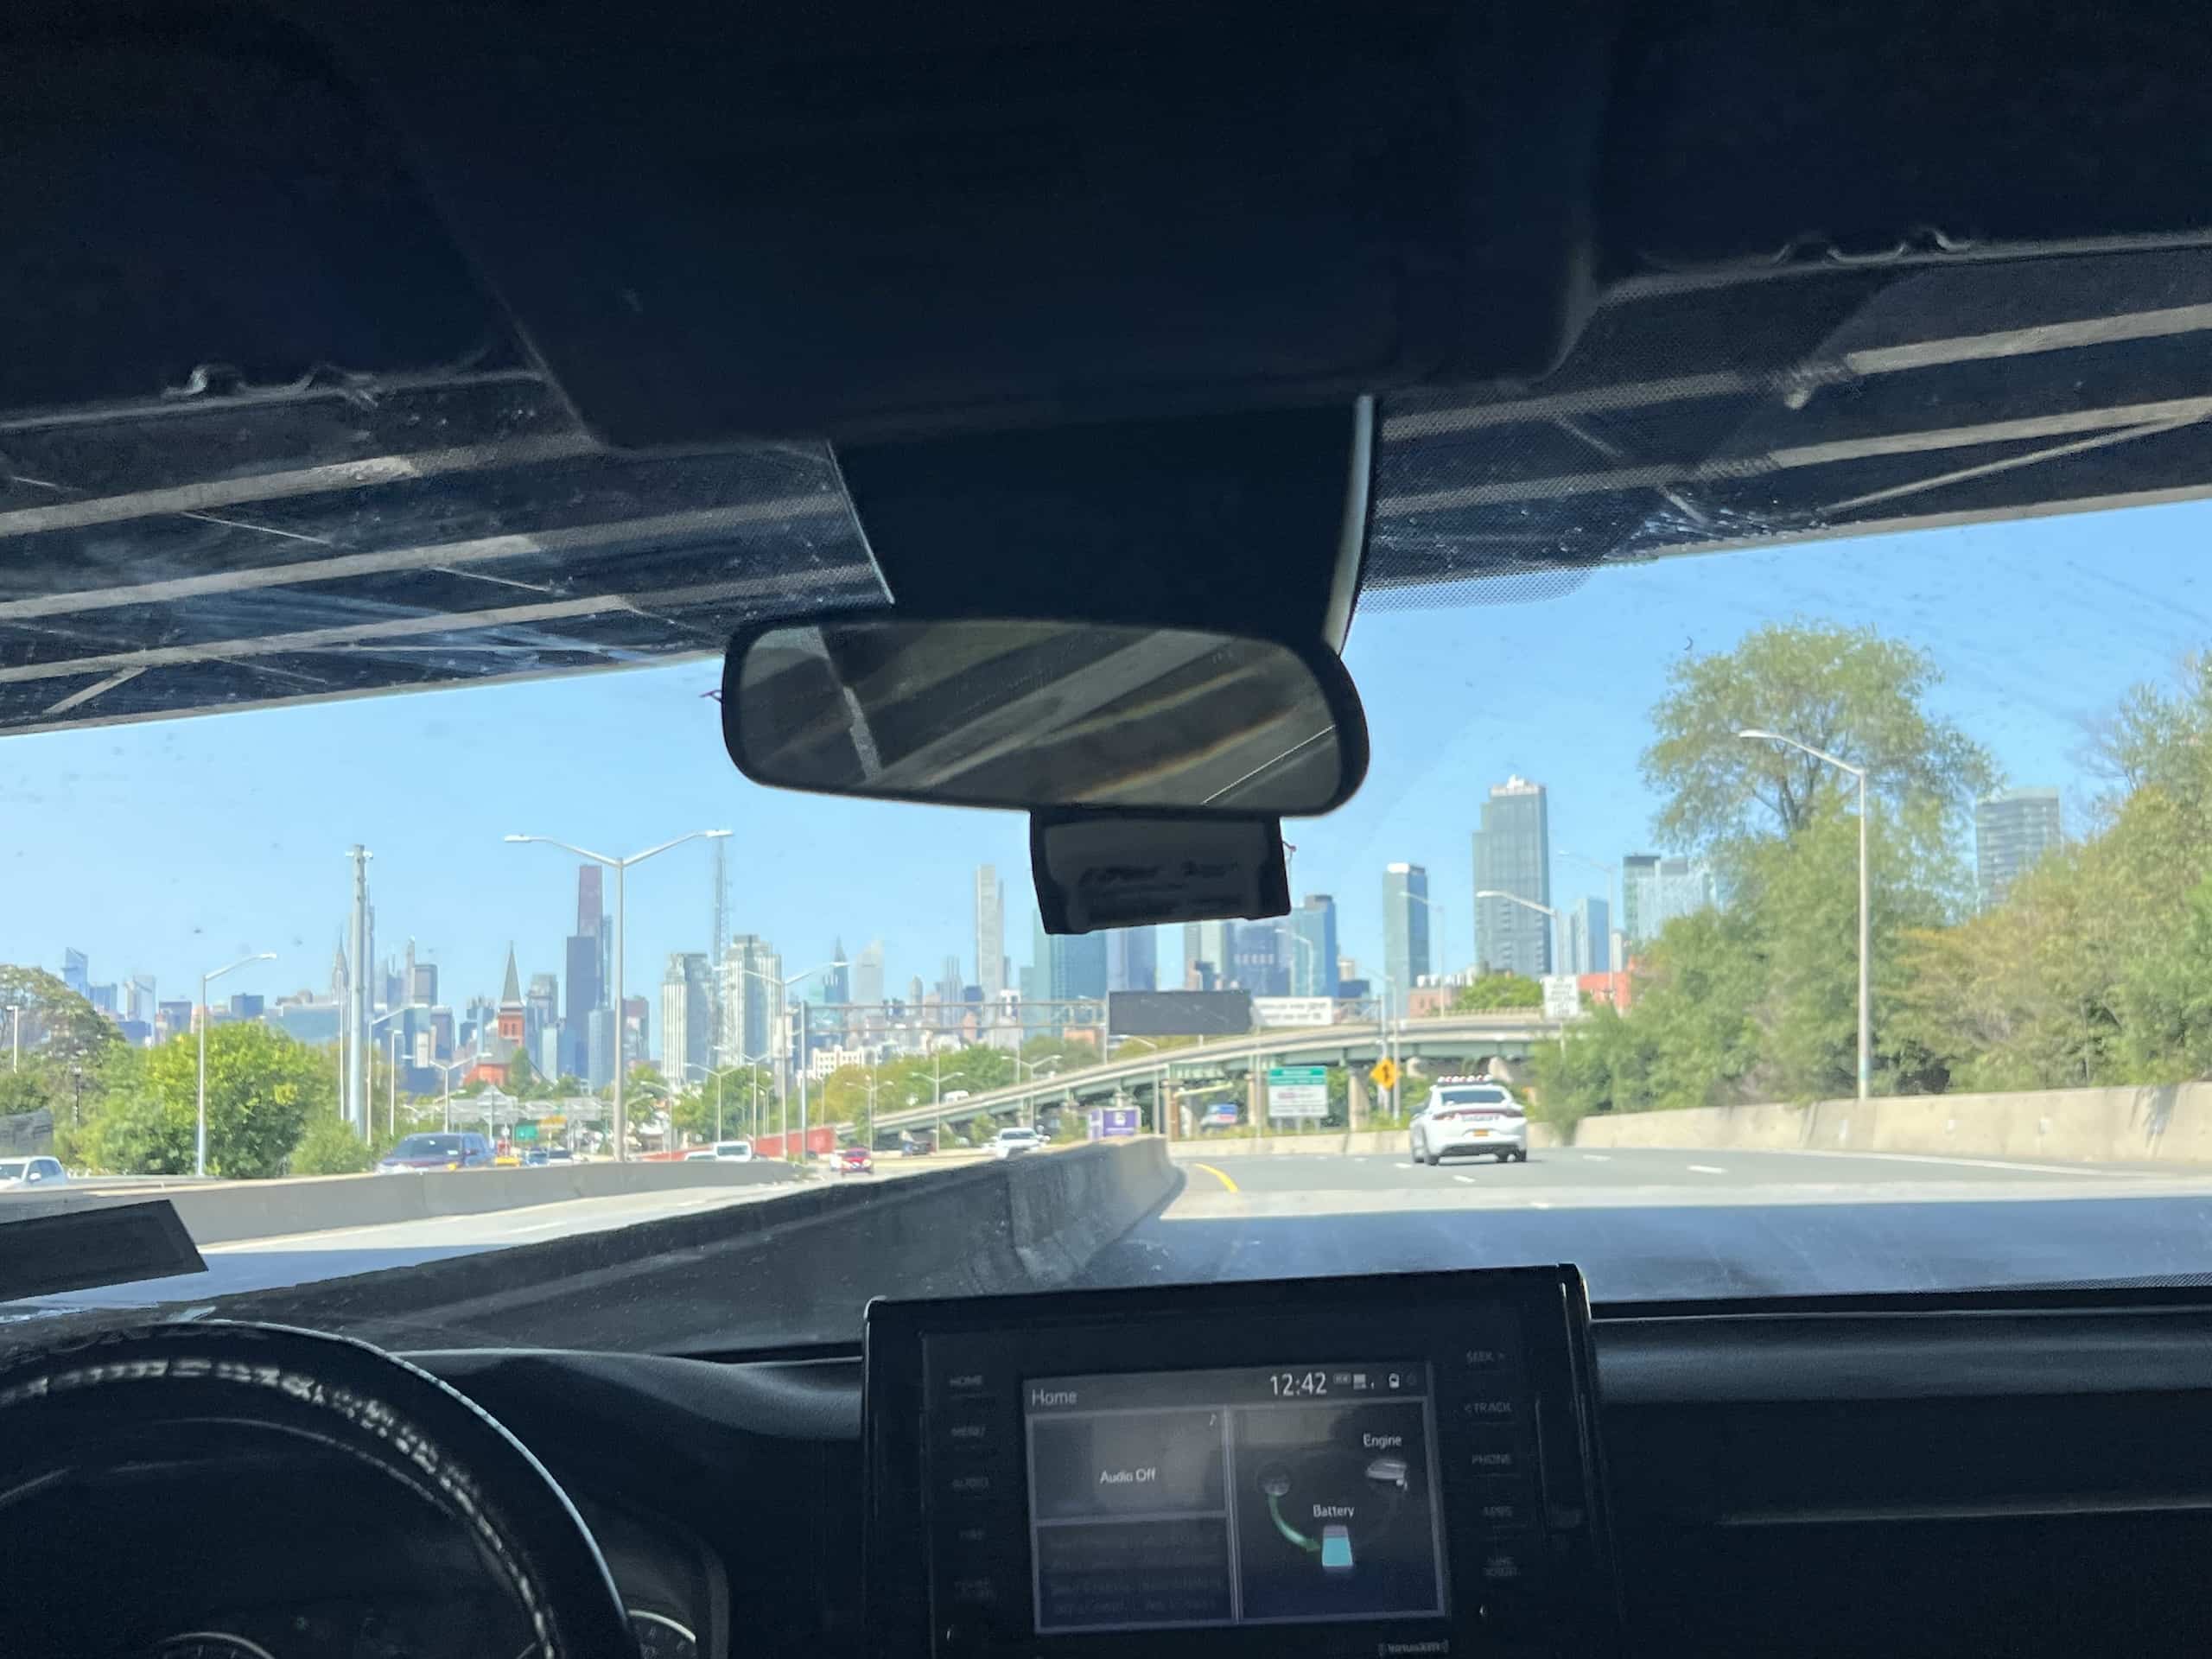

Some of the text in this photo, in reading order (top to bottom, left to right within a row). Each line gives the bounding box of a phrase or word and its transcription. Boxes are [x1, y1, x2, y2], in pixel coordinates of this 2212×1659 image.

[1270, 1371, 1327, 1396] 12:42
[1031, 1388, 1077, 1405] Home
[1362, 1433, 1402, 1449] Engine
[1099, 1466, 1157, 1484] Audio Off
[1313, 1503, 1356, 1520] Battery
